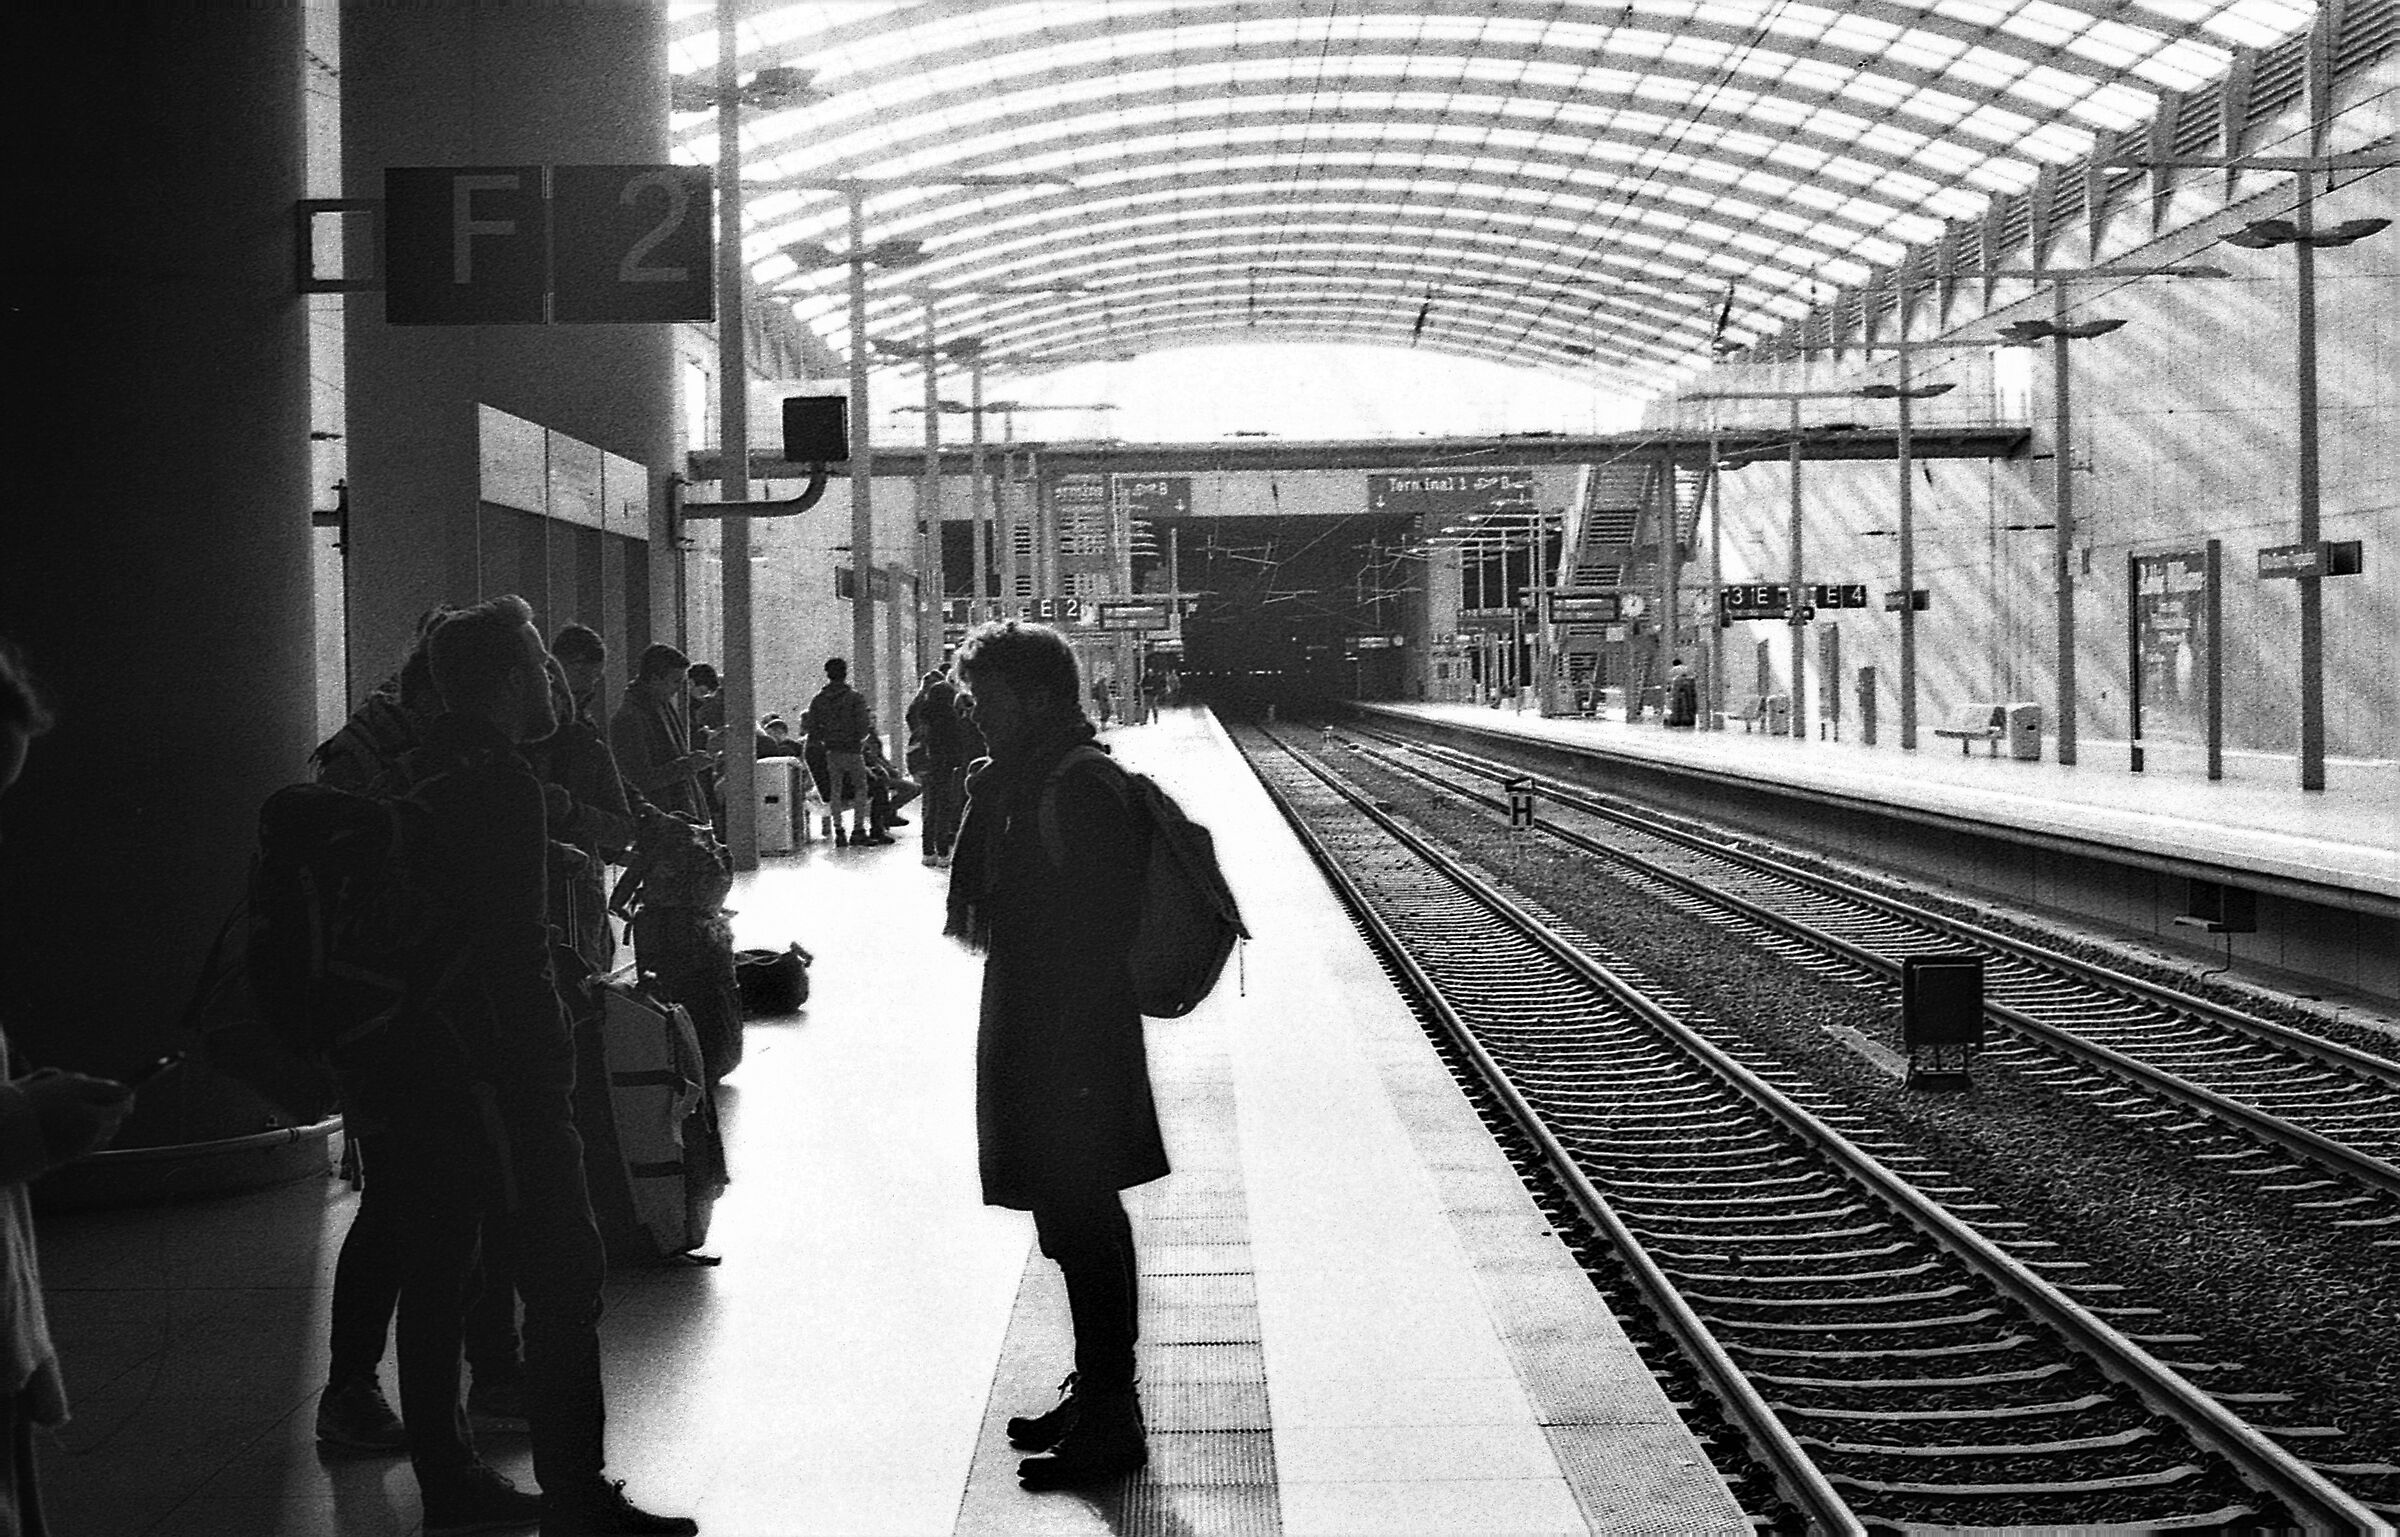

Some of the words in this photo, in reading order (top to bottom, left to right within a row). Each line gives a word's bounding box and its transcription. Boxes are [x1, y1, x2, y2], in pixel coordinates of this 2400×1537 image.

[453, 174, 520, 284] F
[618, 170, 690, 282] 2
[1731, 588, 1743, 604] 3
[1757, 588, 1768, 604] E
[1827, 588, 1839, 603] E
[1850, 586, 1862, 602] 4
[1041, 600, 1052, 617] E
[1066, 600, 1078, 616] 2
[1511, 796, 1532, 826] H
